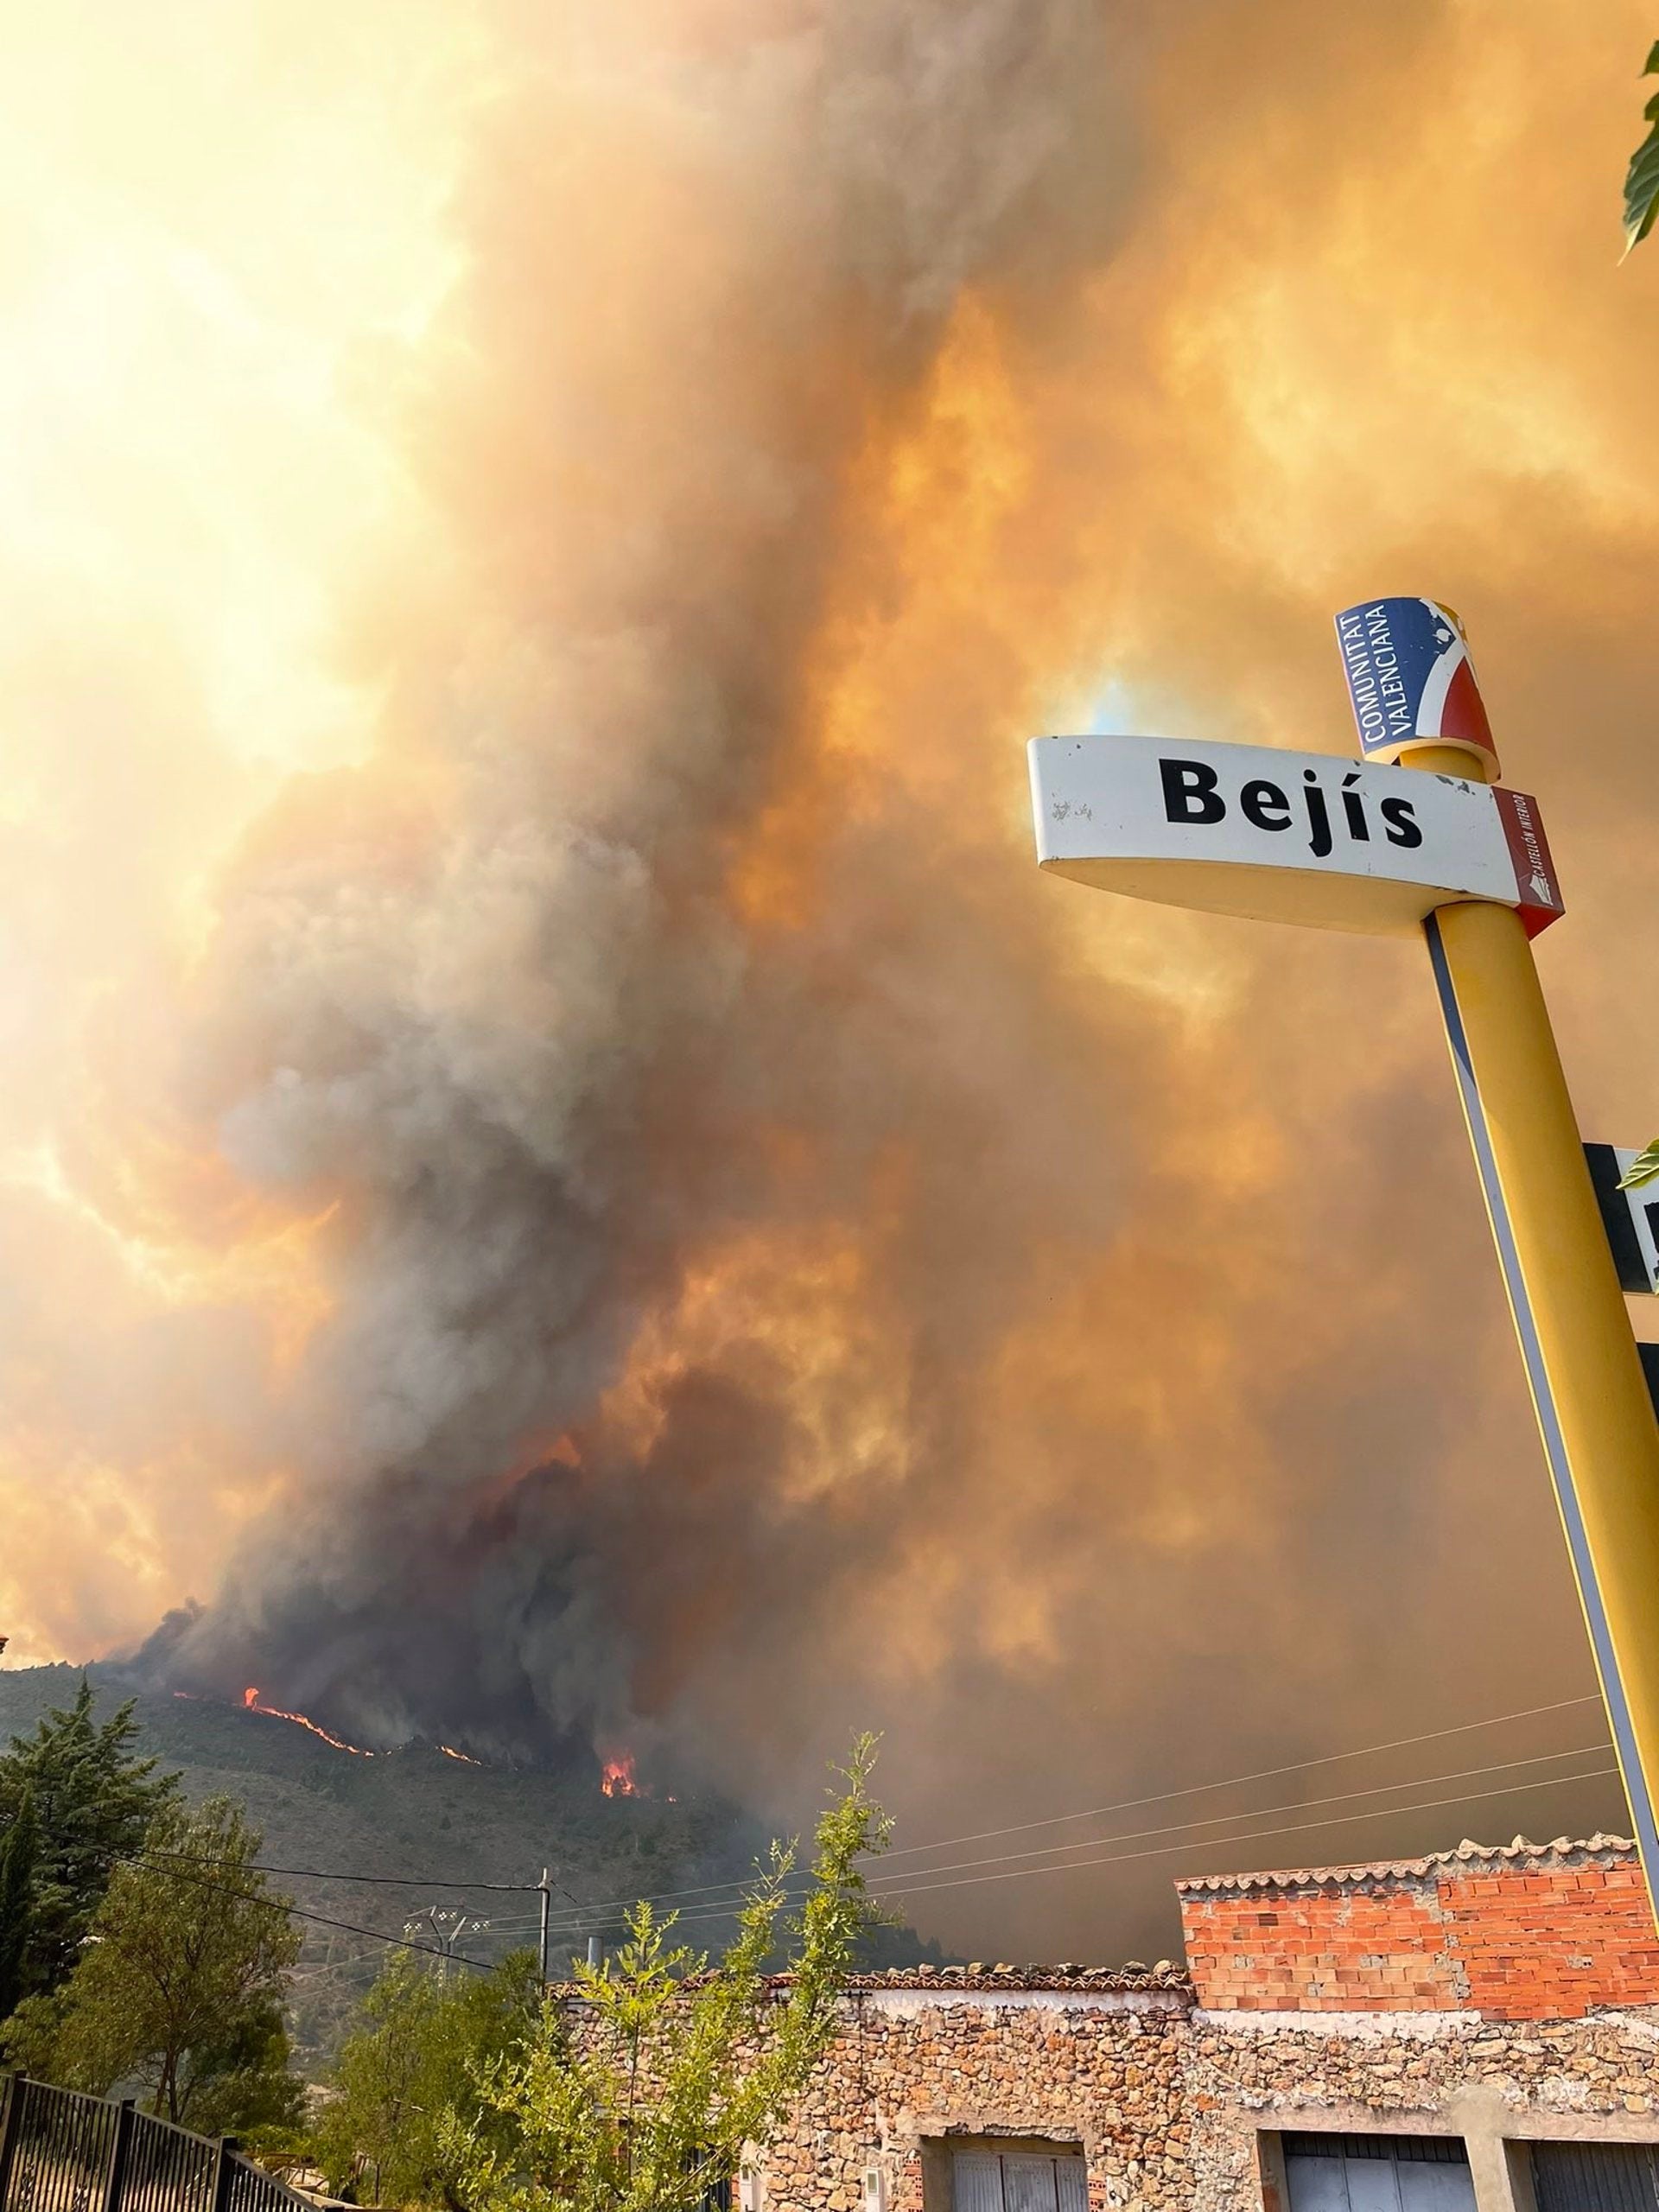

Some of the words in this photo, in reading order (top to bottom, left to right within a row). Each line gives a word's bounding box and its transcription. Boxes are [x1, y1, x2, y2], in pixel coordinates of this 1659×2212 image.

[1339, 614, 1387, 743] COMUNITAT
[1365, 604, 1413, 736] VALENCIANA
[1158, 758, 1423, 858] Bejís
[1512, 793, 1534, 830] INTERIOR
[1522, 831, 1546, 877] CASTELLÓN
